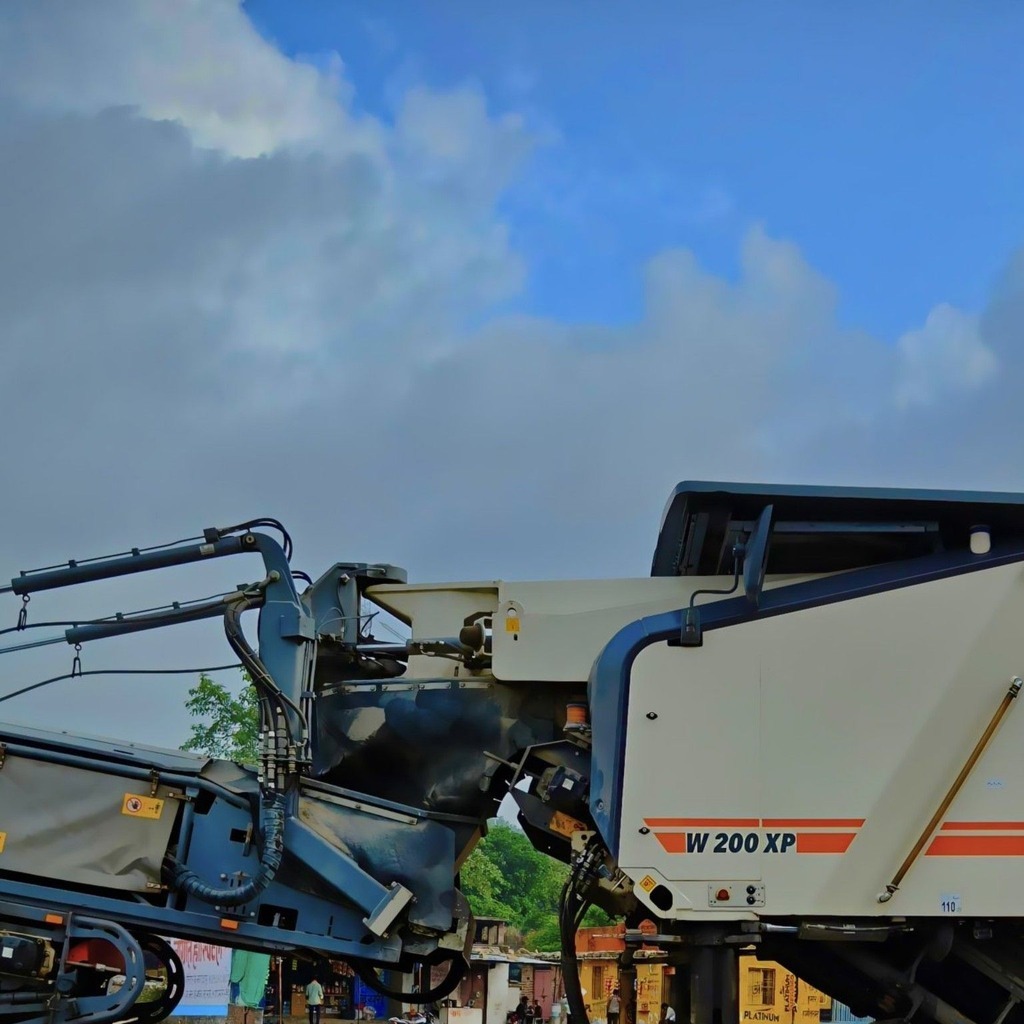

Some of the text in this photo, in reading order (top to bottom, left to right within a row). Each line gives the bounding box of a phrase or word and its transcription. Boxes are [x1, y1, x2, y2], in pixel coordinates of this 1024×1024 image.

[686, 833, 796, 853] W 200 XP
[941, 901, 956, 912] 110
[743, 1010, 780, 1022] PLATINUM
